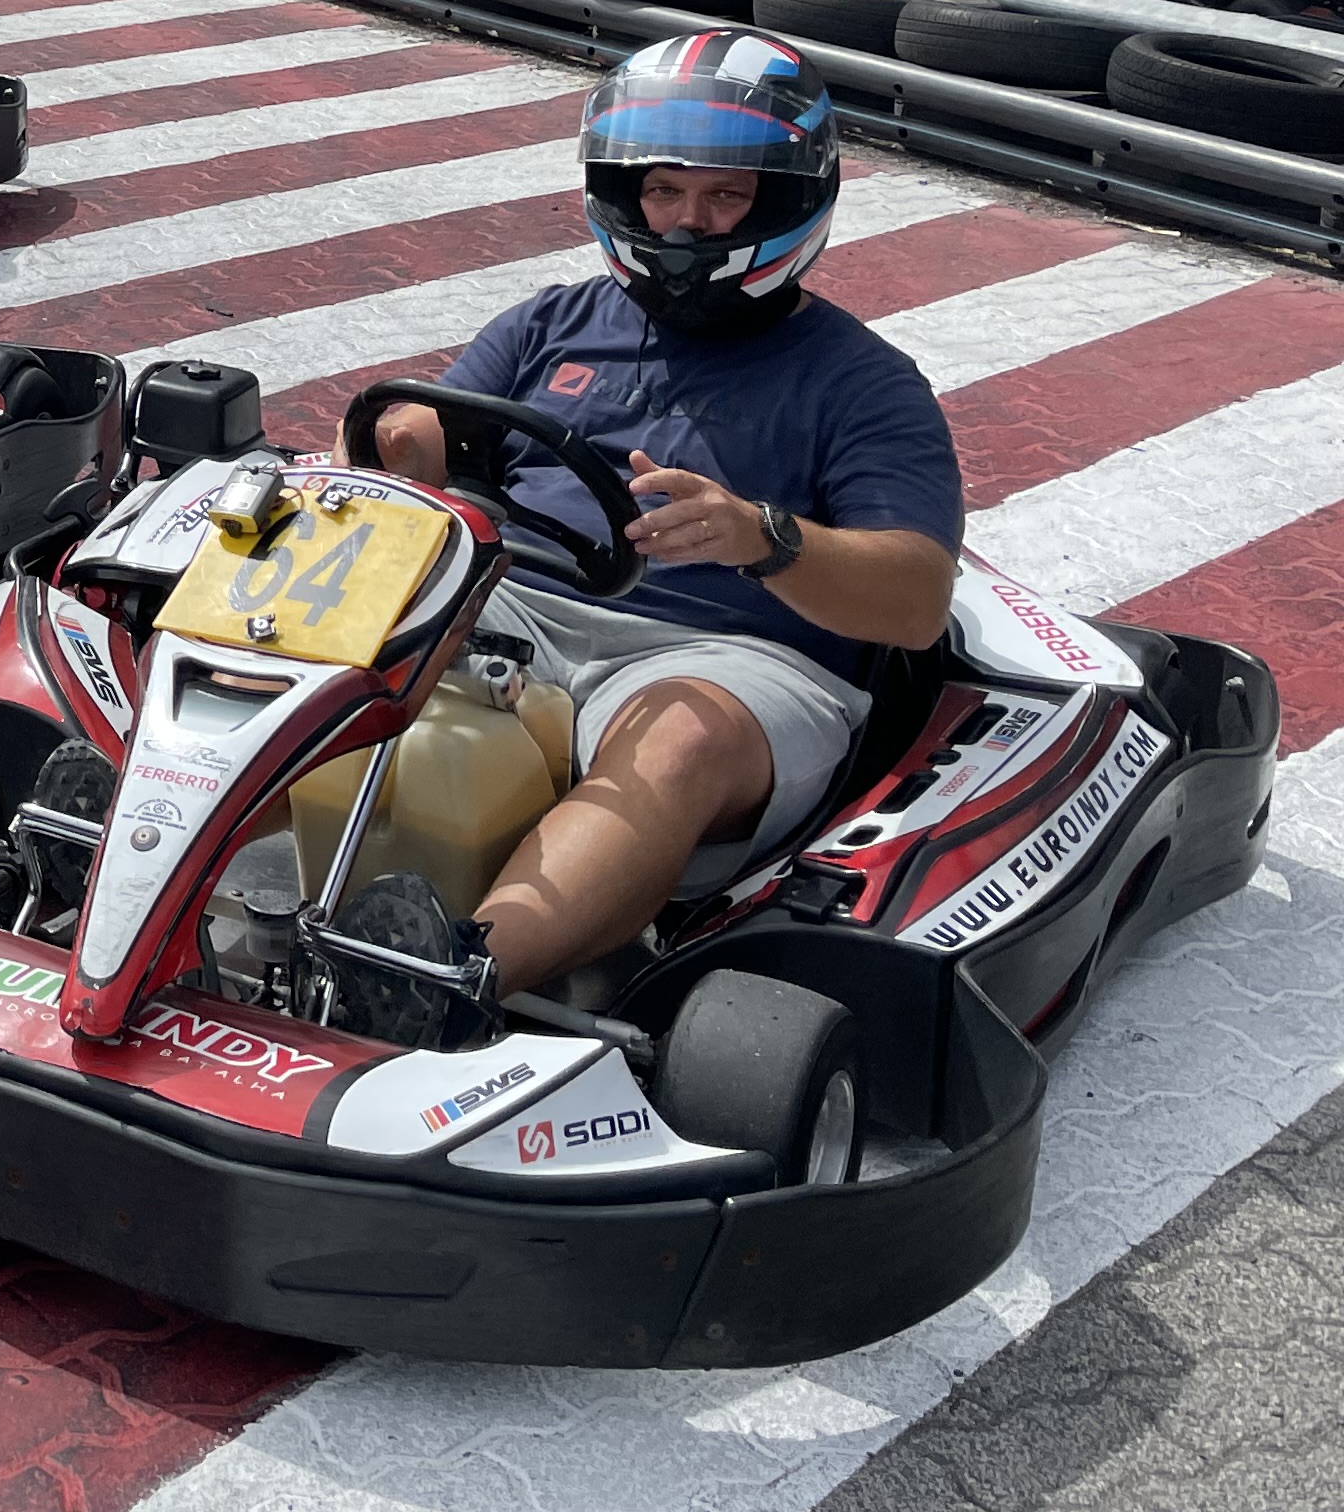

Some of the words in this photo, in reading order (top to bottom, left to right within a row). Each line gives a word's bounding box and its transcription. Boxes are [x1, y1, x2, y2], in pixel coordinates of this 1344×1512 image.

[229, 509, 376, 627] 64
[991, 583, 1103, 673] FERBERTO
[74, 638, 124, 710] SWS
[131, 764, 220, 792] FERBERTO
[923, 722, 1160, 948] WWW.EUROINDY.COM
[159, 1048, 286, 1100] BATALHA
[453, 1061, 537, 1114] SWS
[563, 1107, 652, 1148] SODI
